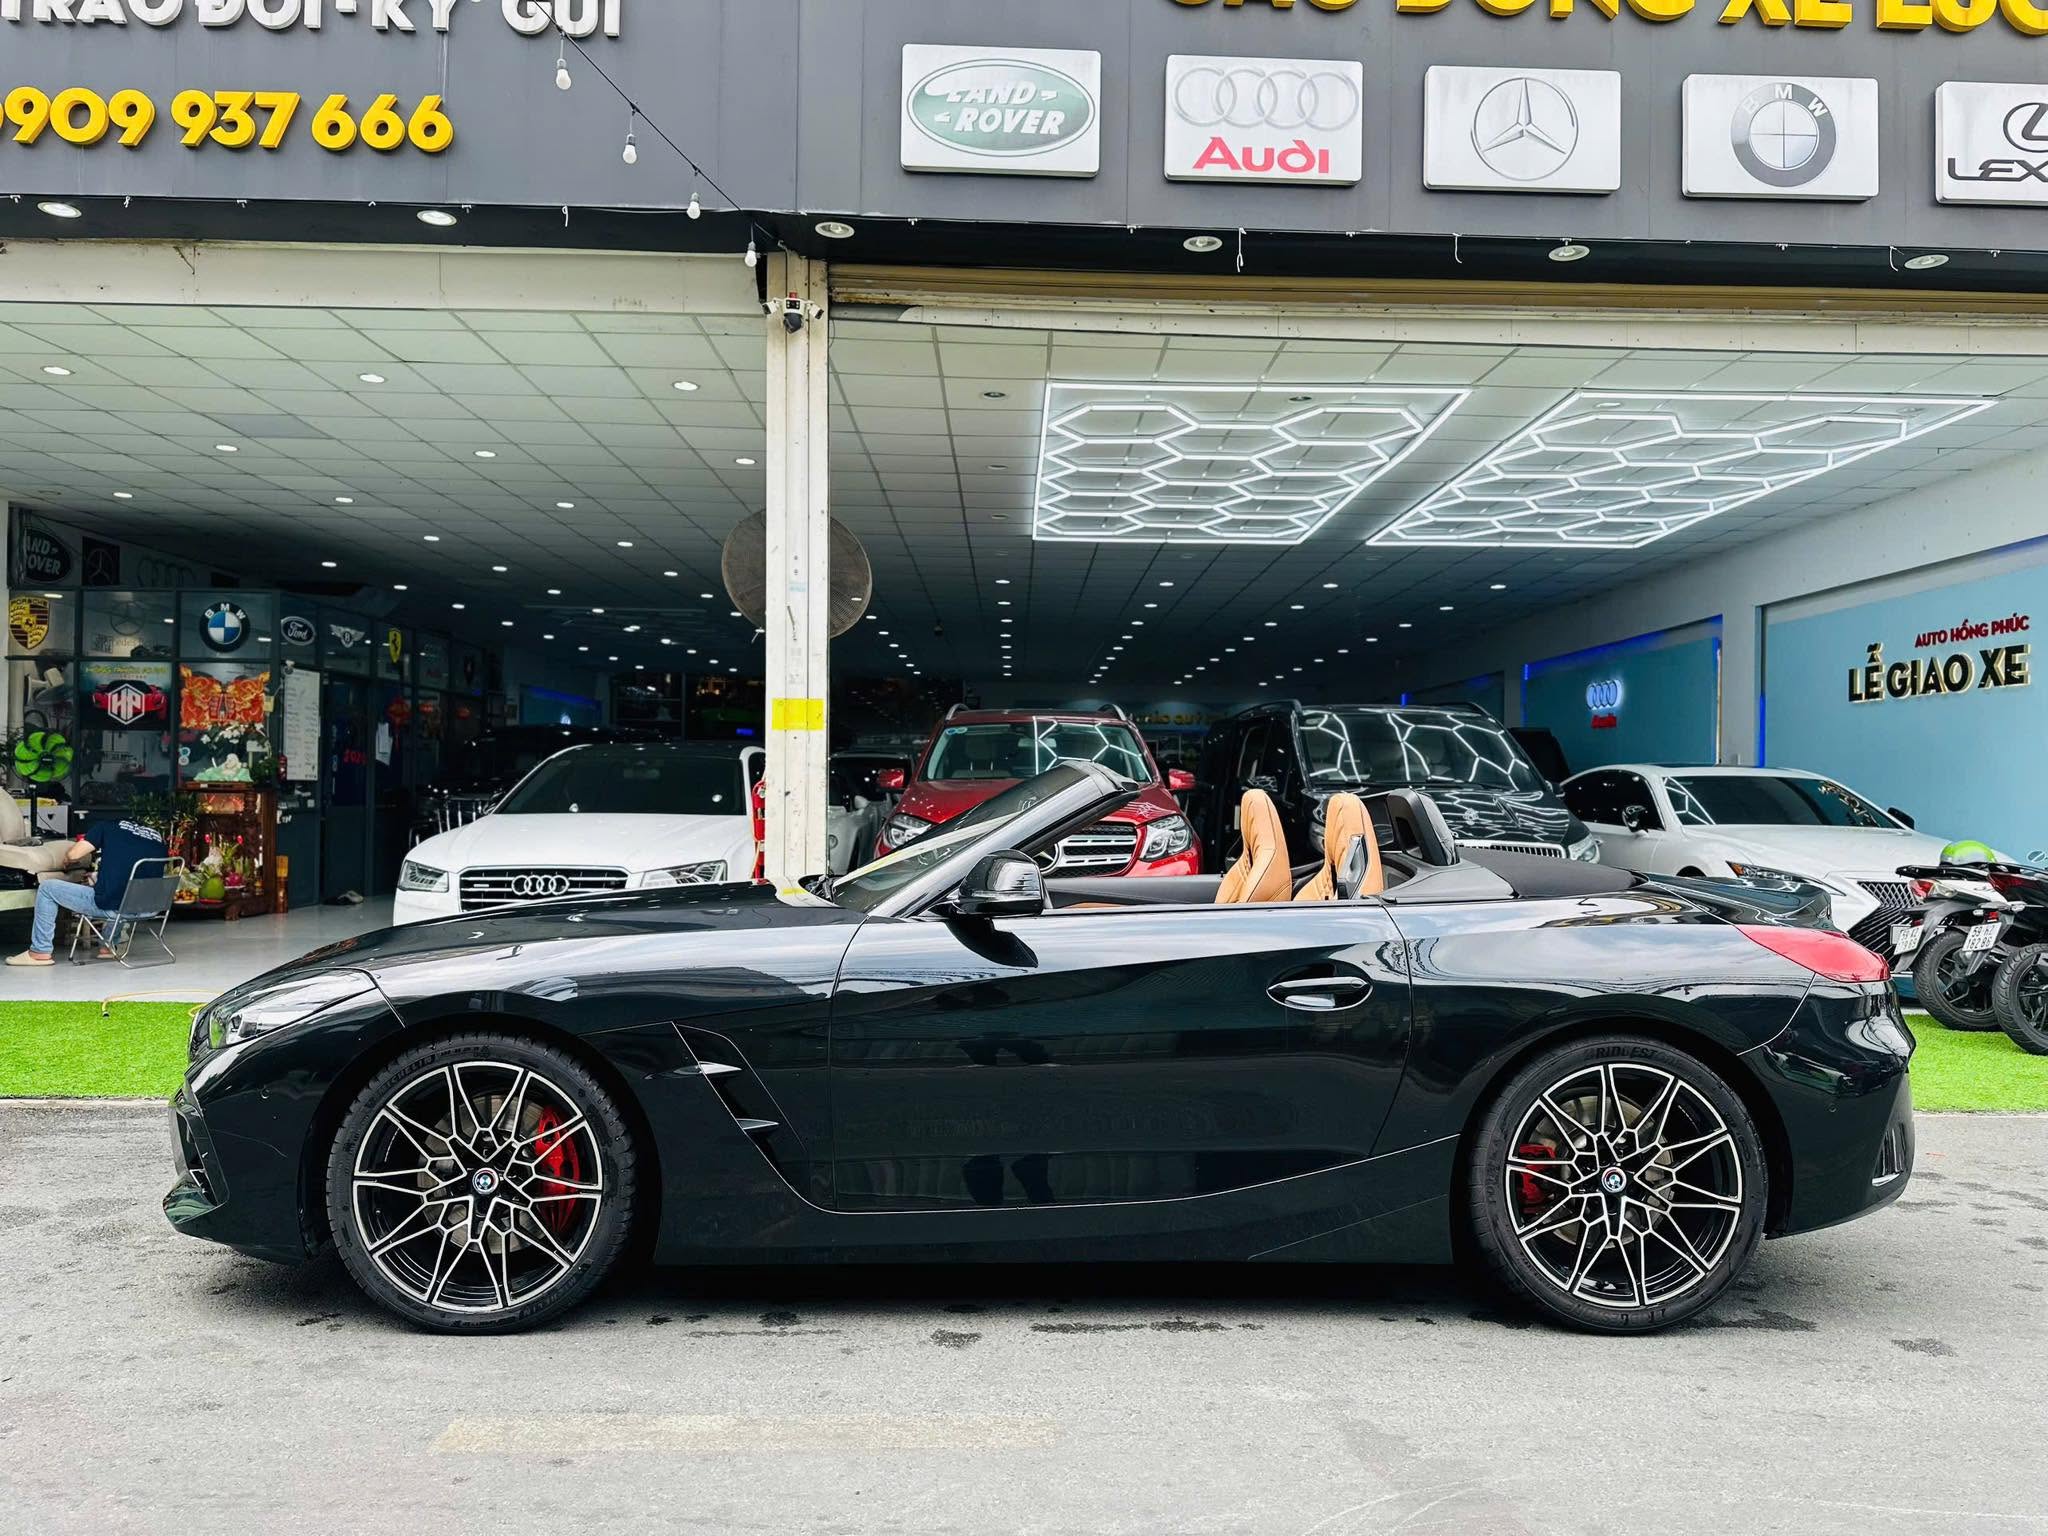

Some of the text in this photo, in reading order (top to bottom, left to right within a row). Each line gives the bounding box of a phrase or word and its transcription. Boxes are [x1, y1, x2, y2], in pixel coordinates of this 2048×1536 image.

[0, 86, 455, 154] 909 937 666
[954, 107, 1066, 136] ROVER
[1192, 136, 1330, 174] Audi
[27, 553, 62, 576] OVER
[204, 603, 246, 620] BMW
[287, 621, 308, 640] Ford
[1914, 630, 1949, 648] AUTO
[1991, 612, 2030, 636] PHÚC
[1848, 641, 2032, 704] LỄ GIAO XE
